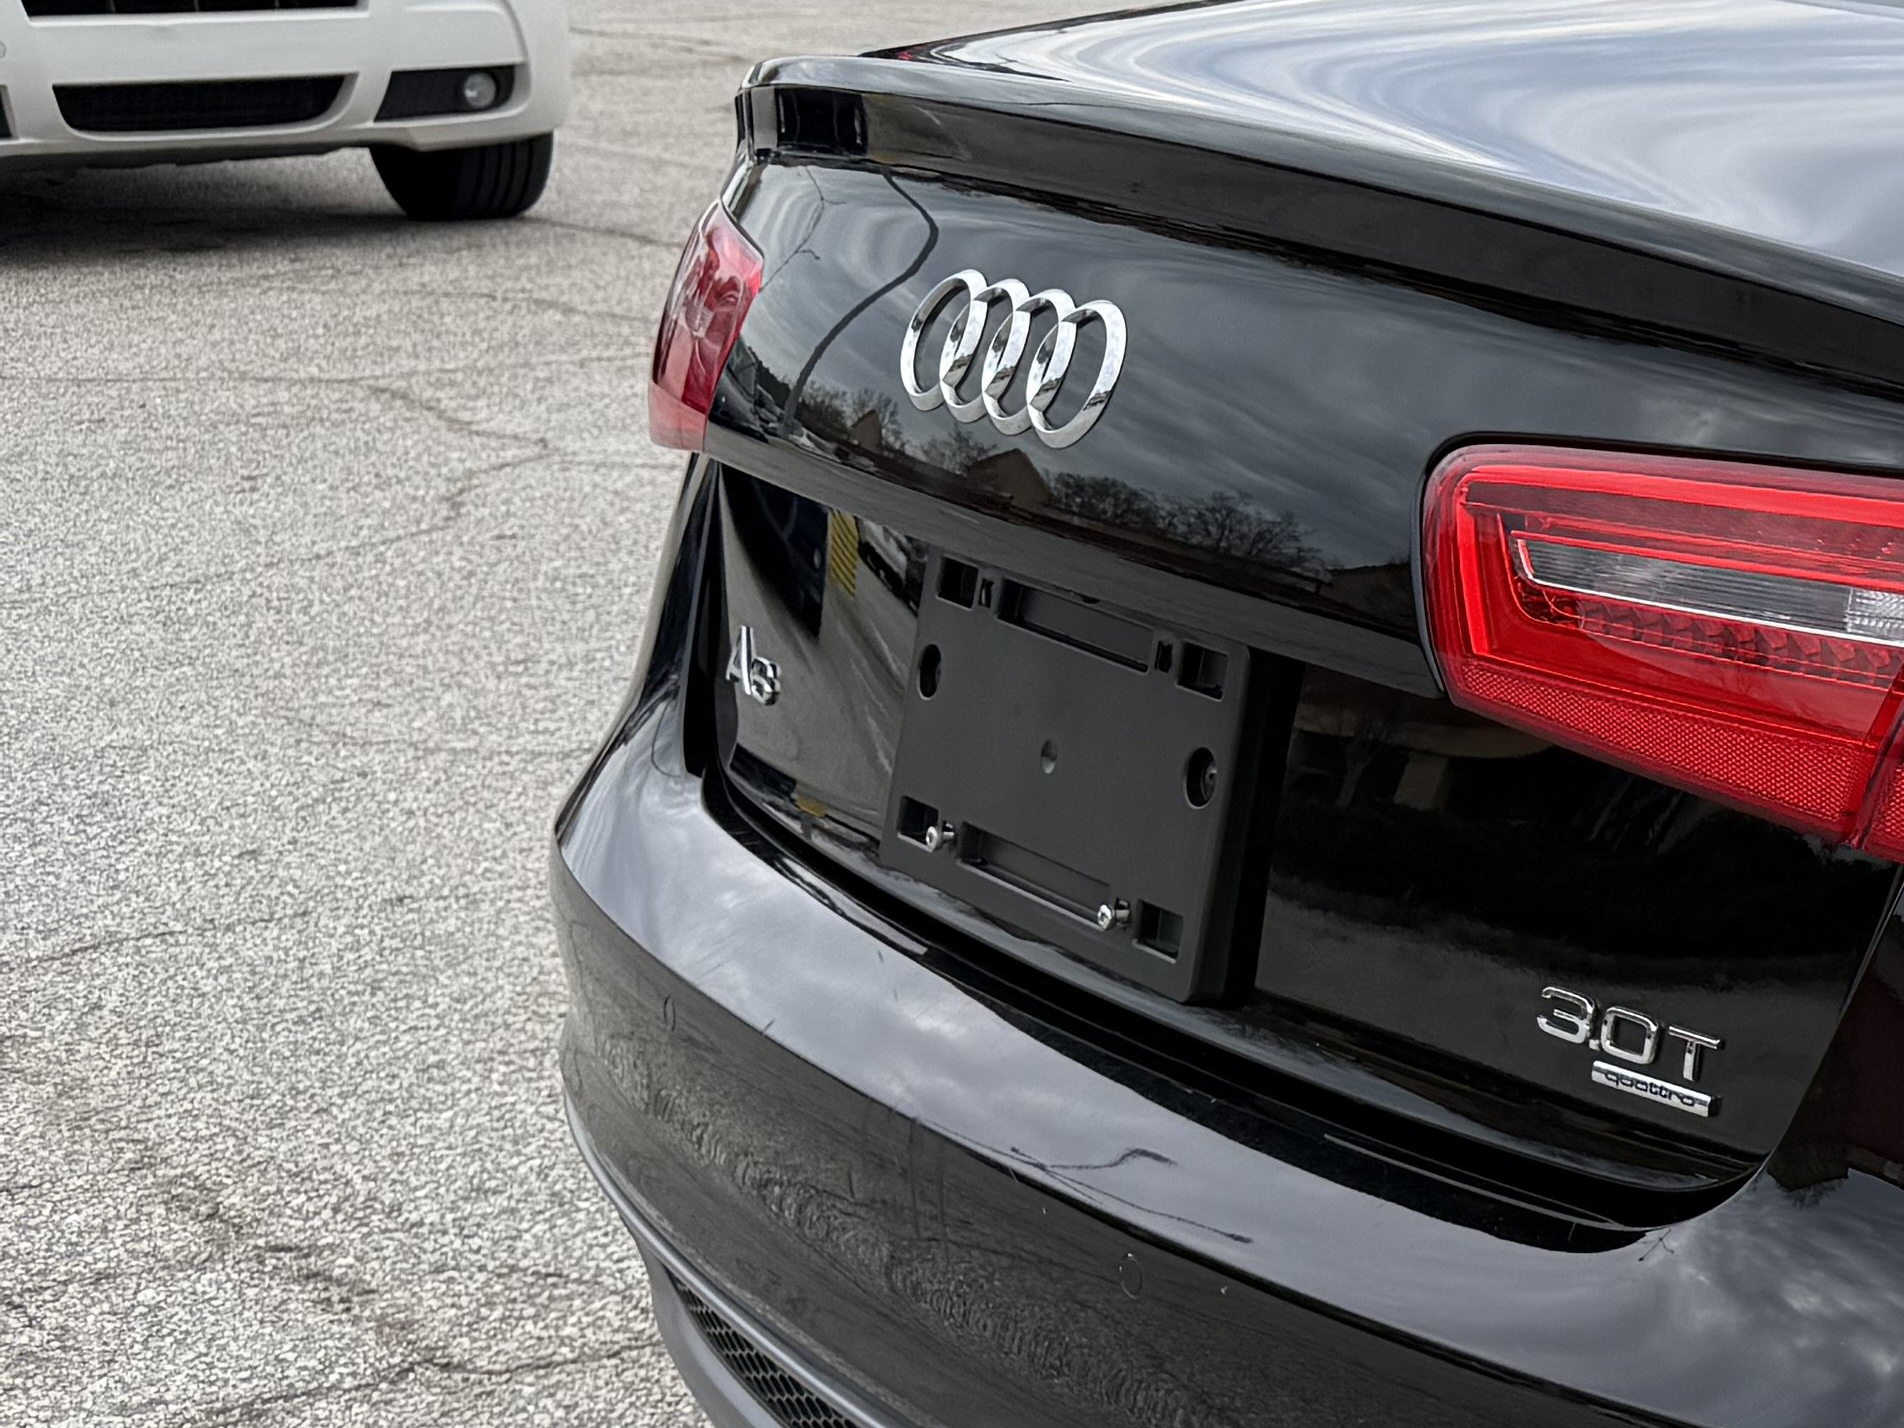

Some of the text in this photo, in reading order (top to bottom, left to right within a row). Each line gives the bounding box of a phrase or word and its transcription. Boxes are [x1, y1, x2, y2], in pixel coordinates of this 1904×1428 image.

[726, 625, 782, 705] A6
[1537, 986, 1721, 1082] 3.0T
[1603, 1071, 1696, 1108] quattro
